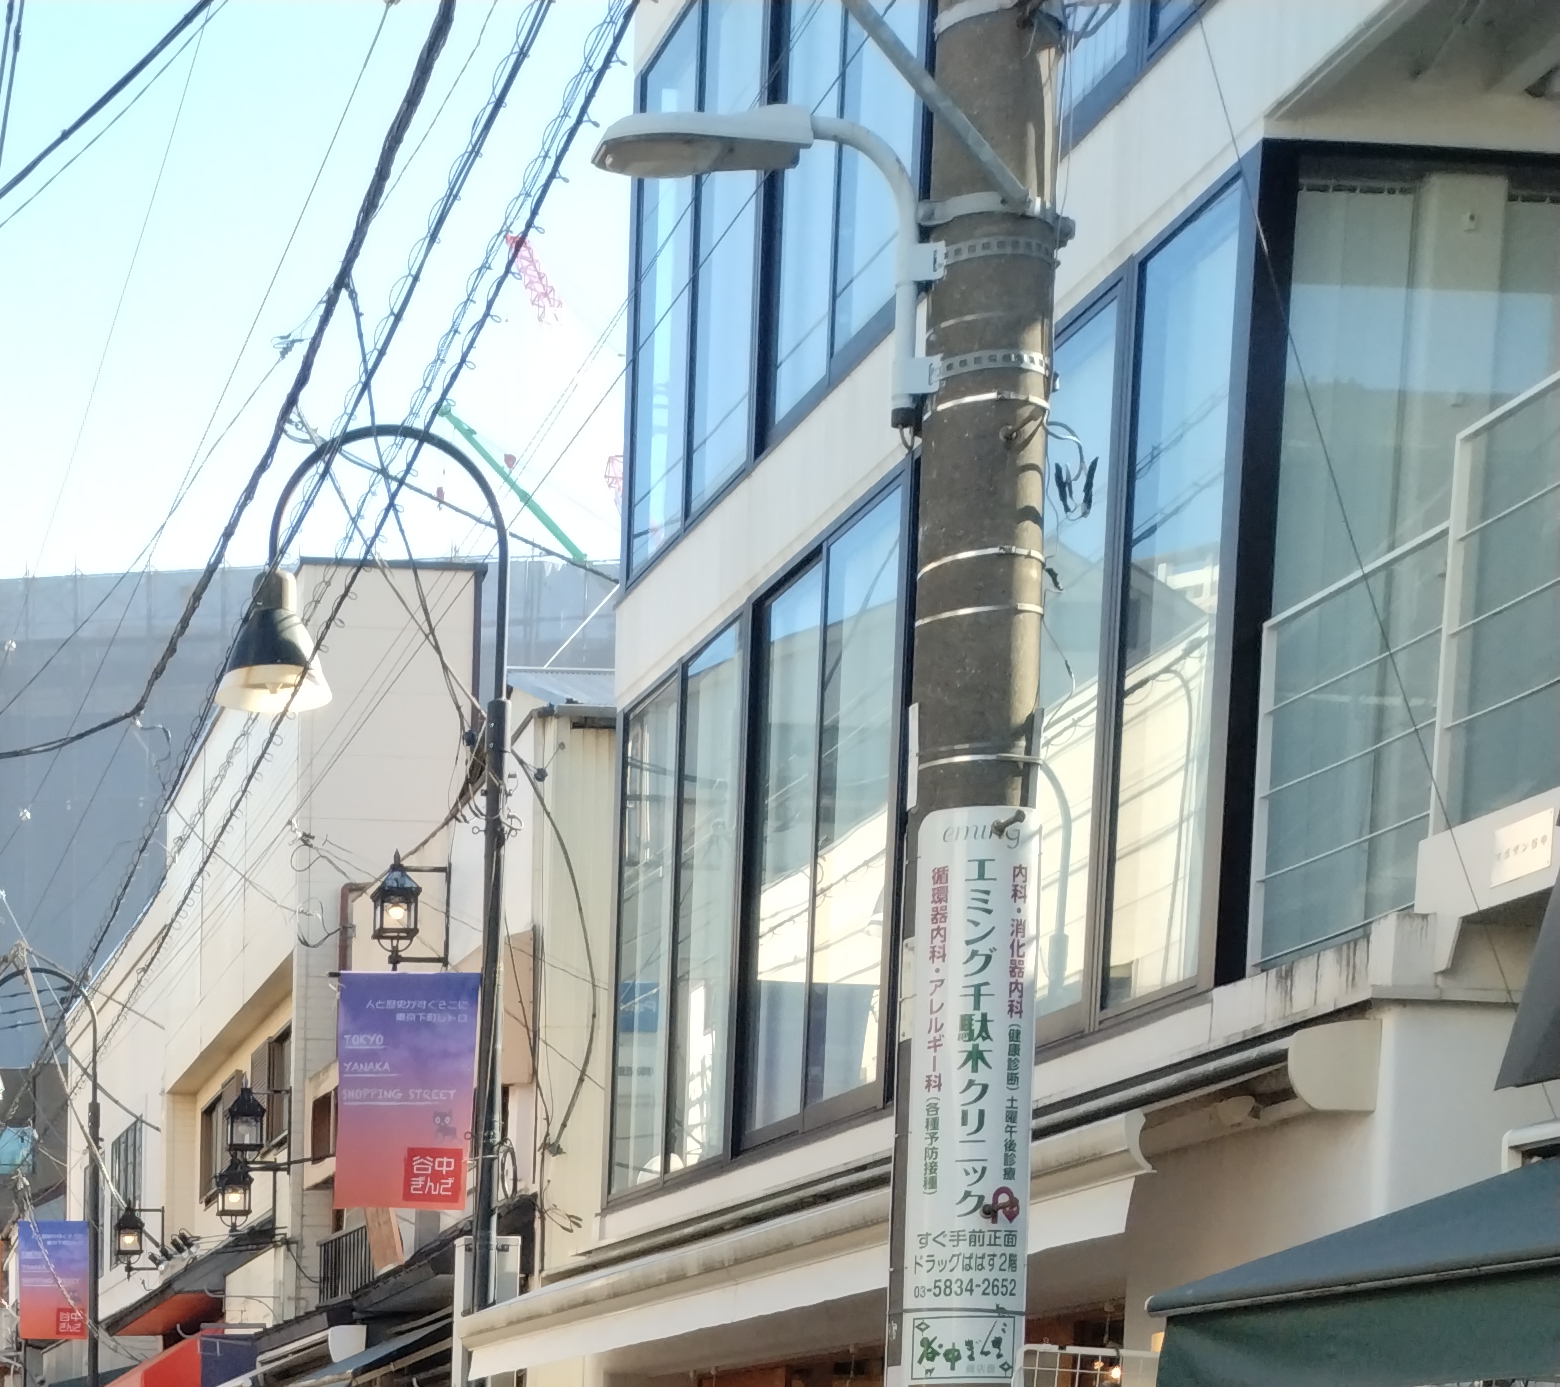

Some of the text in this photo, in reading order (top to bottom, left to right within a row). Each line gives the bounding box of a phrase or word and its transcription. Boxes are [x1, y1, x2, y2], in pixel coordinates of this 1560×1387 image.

[343, 1034, 384, 1045] TOKYO
[954, 858, 998, 1218] エミング千駄木クリニック
[342, 1061, 391, 1072] YANAKA
[342, 1088, 457, 1100] SHOPPING STREET
[411, 1156, 456, 1175] 谷中
[410, 1176, 455, 1196] ぎんざ
[916, 1228, 1018, 1250] すぐ手前正面
[913, 1277, 1017, 1299] 03-5834-2652
